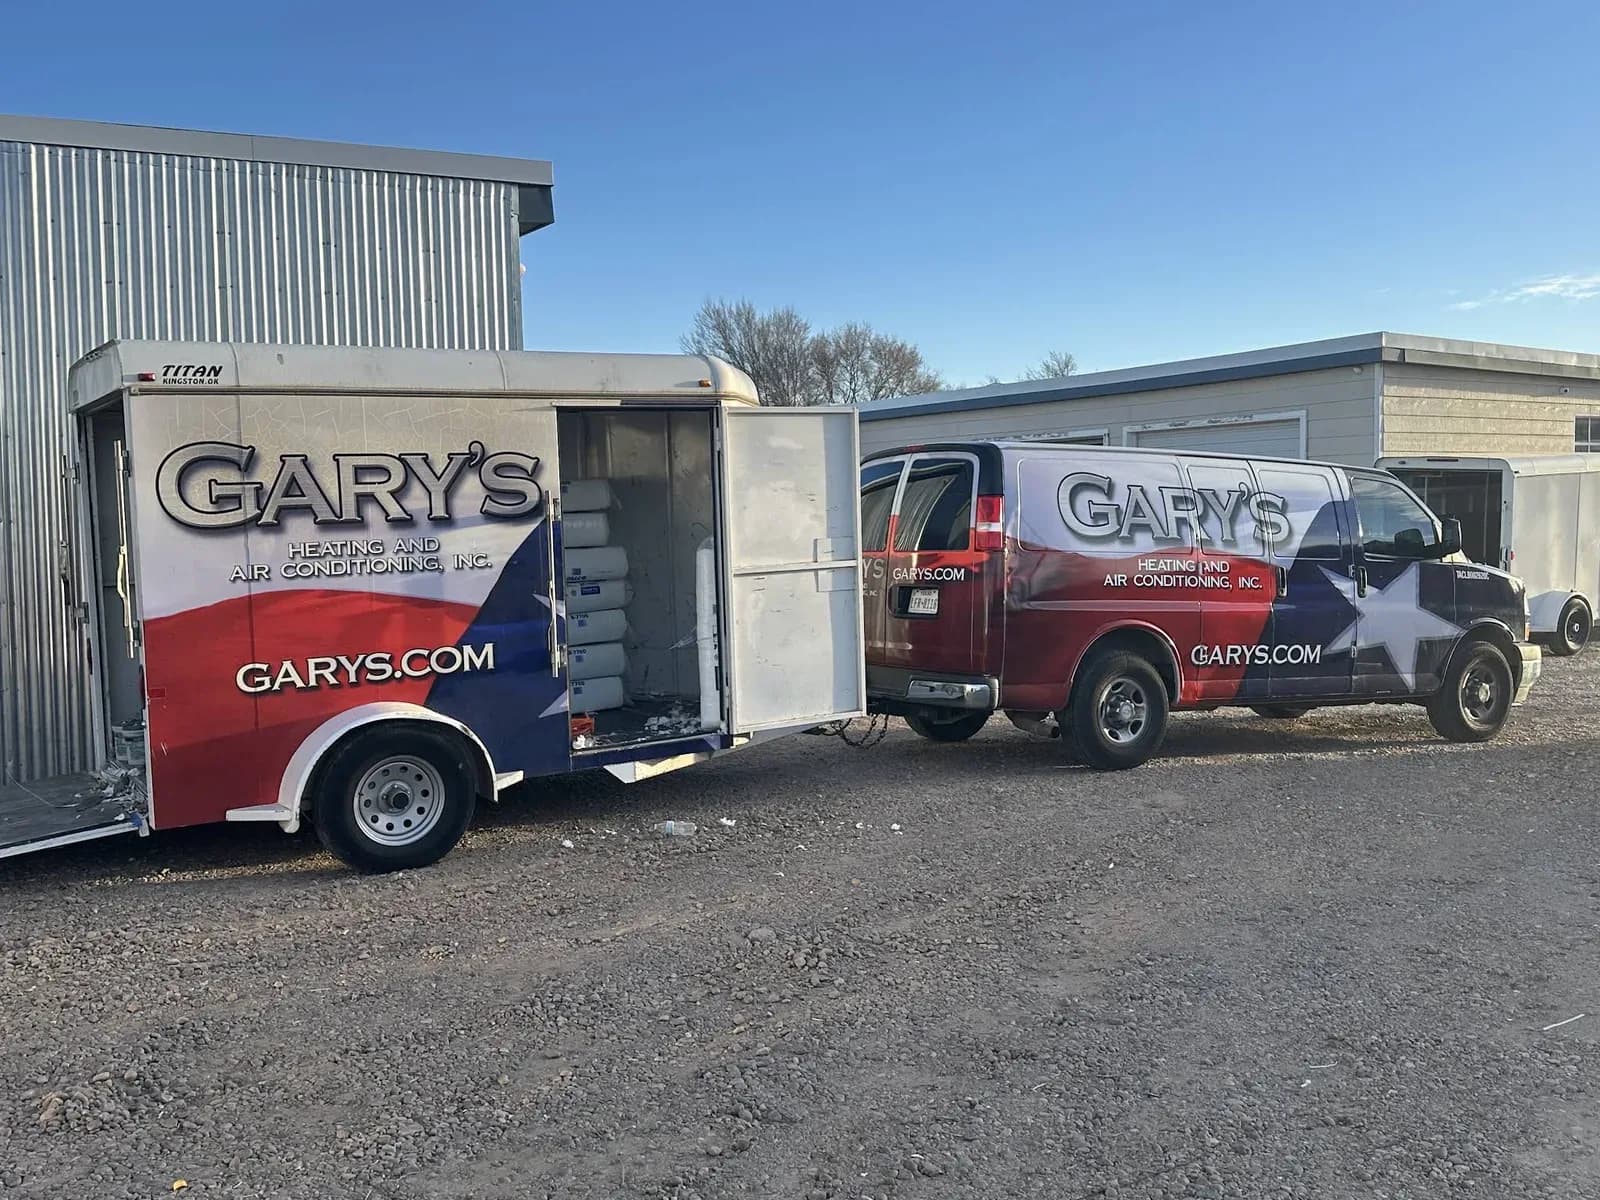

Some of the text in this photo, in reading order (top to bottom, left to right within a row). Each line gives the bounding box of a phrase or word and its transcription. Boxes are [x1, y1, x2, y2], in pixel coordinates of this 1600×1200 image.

[162, 365, 223, 377] TITAN
[155, 440, 542, 529] GARY'S
[1056, 471, 1292, 543] GARY'S
[288, 537, 440, 559] HEATING AND
[229, 553, 493, 583] AIR CONDITIONING, INC.
[892, 567, 965, 581] GARYS.COM
[1138, 559, 1230, 573] HEATING AND
[1104, 574, 1263, 591] AIR CONDITIONING, INC.
[1191, 643, 1322, 665] GARYS.COM
[235, 642, 495, 693] GARYS.COM
